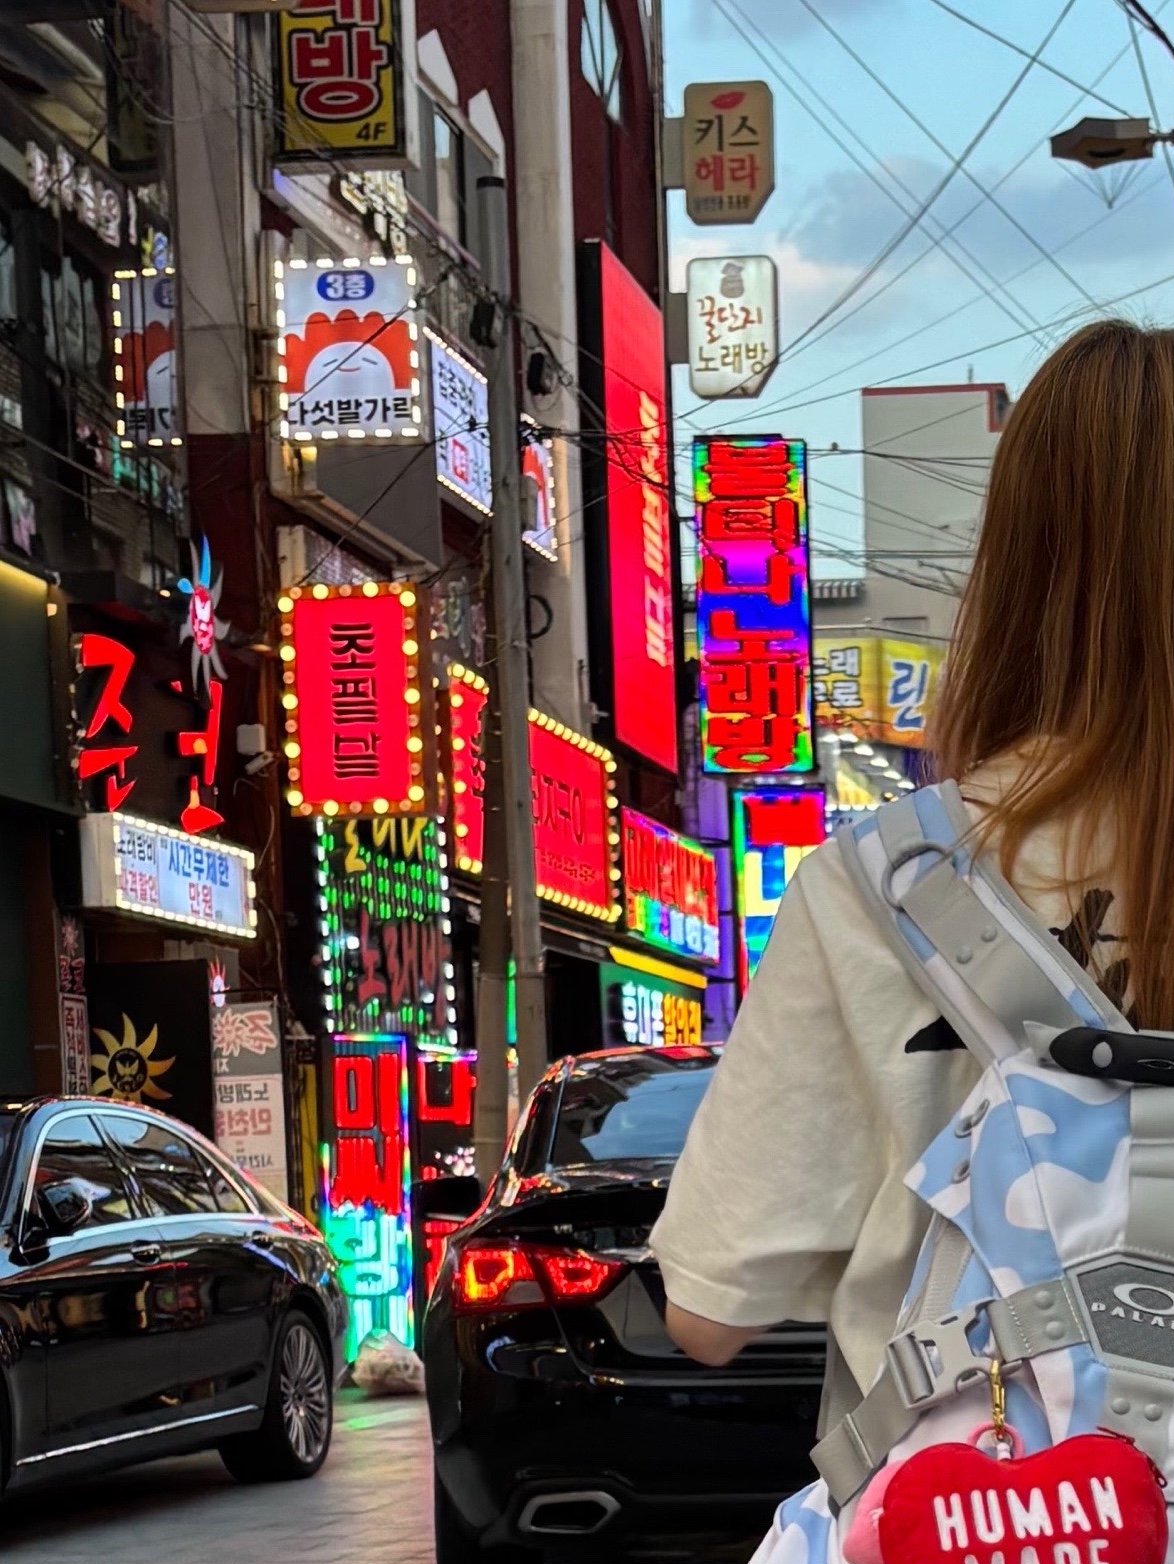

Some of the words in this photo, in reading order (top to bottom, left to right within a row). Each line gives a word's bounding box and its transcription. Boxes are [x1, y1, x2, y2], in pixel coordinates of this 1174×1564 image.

[356, 122, 386, 141] 4F
[695, 115, 759, 152] 키스
[694, 154, 760, 192] 헤라
[698, 296, 763, 343] 꿀단지
[694, 342, 769, 375] 노래방
[169, 841, 230, 888] 시간무제한
[933, 1476, 1124, 1552] HUMAN
